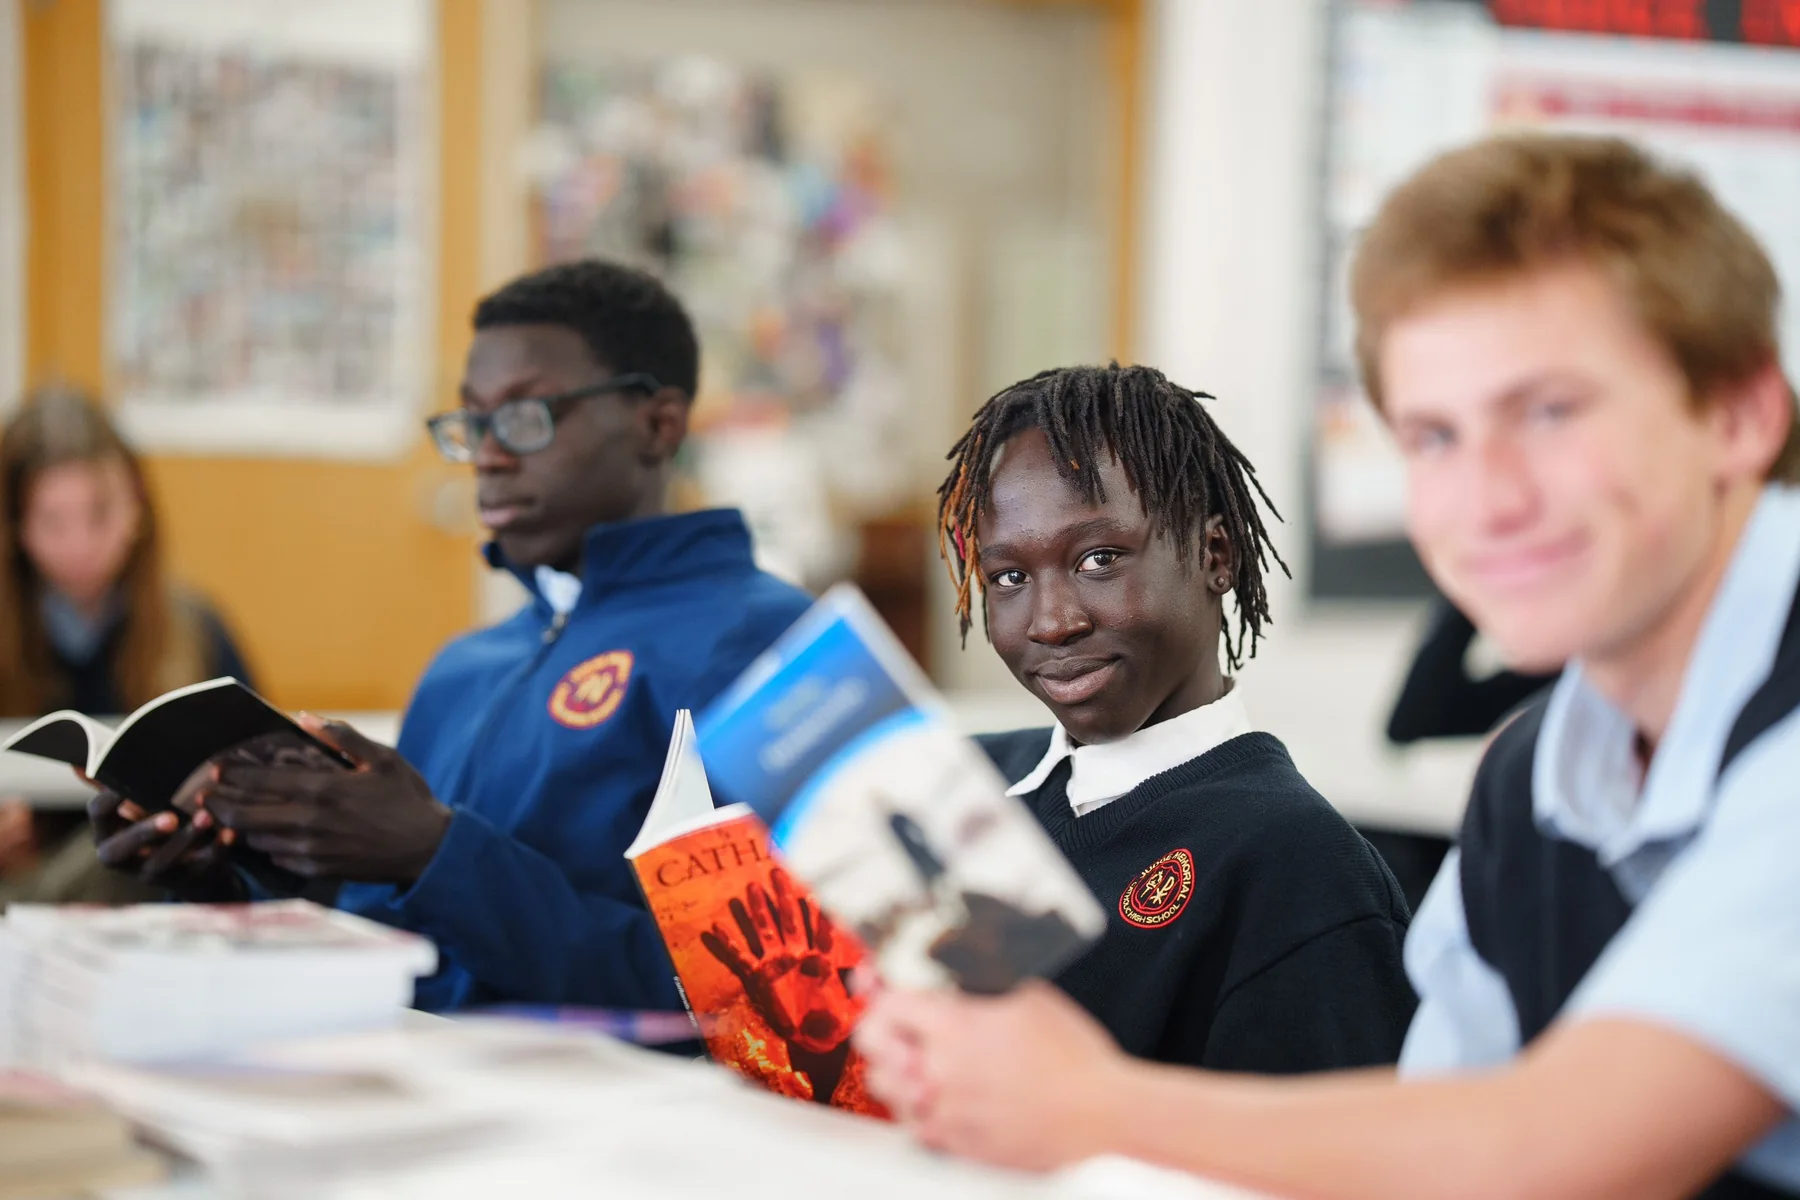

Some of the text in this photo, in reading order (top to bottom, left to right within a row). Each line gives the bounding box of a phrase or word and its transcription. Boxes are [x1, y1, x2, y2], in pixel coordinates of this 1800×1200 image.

[656, 839, 771, 887] CATH
[1172, 851, 1191, 901] MEMORIAL
[1127, 911, 1146, 923] HIGH
[1146, 903, 1180, 924] SCHOOL
